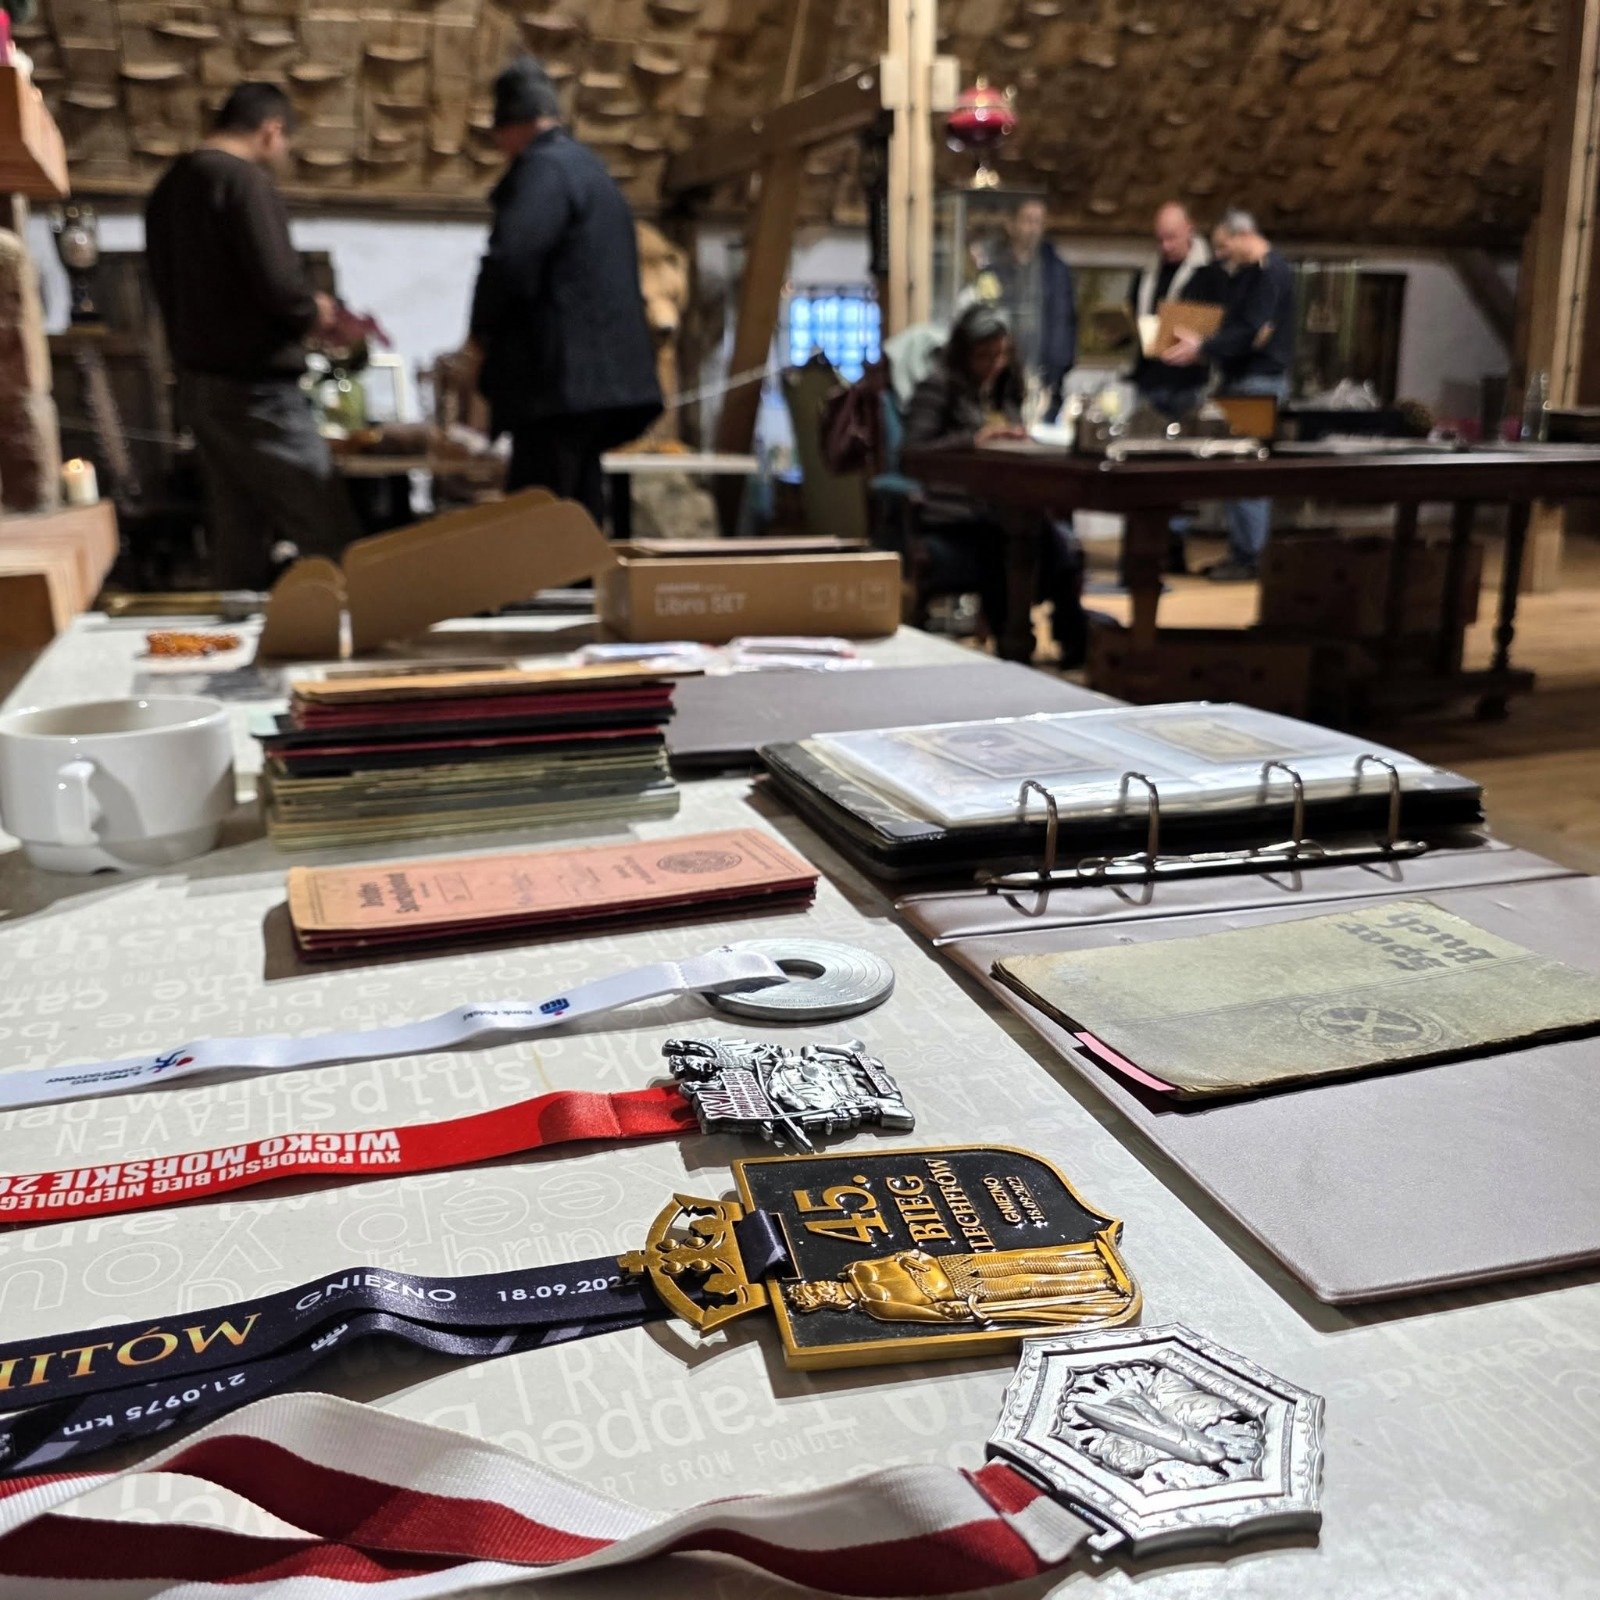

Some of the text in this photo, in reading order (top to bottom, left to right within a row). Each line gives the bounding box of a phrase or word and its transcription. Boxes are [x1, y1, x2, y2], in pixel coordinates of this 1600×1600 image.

[55, 1093, 292, 1157] HEAVEN
[257, 1128, 401, 1157] WICKO
[51, 1145, 249, 1191] MORSKIE
[219, 1151, 356, 1183] POMORSKI
[360, 1149, 402, 1165] XVI
[152, 1171, 212, 1195] BIEG
[981, 1176, 1022, 1224] GNIEZNO
[792, 1174, 891, 1246] 45.
[885, 1174, 955, 1246] BIEG
[294, 1274, 457, 1311] GNIEZNO
[496, 1273, 640, 1303] 18.09.2022
[62, 1372, 246, 1436] 21.0975 km
[660, 1448, 737, 1487] GROW
[752, 1424, 864, 1468] FONDER
